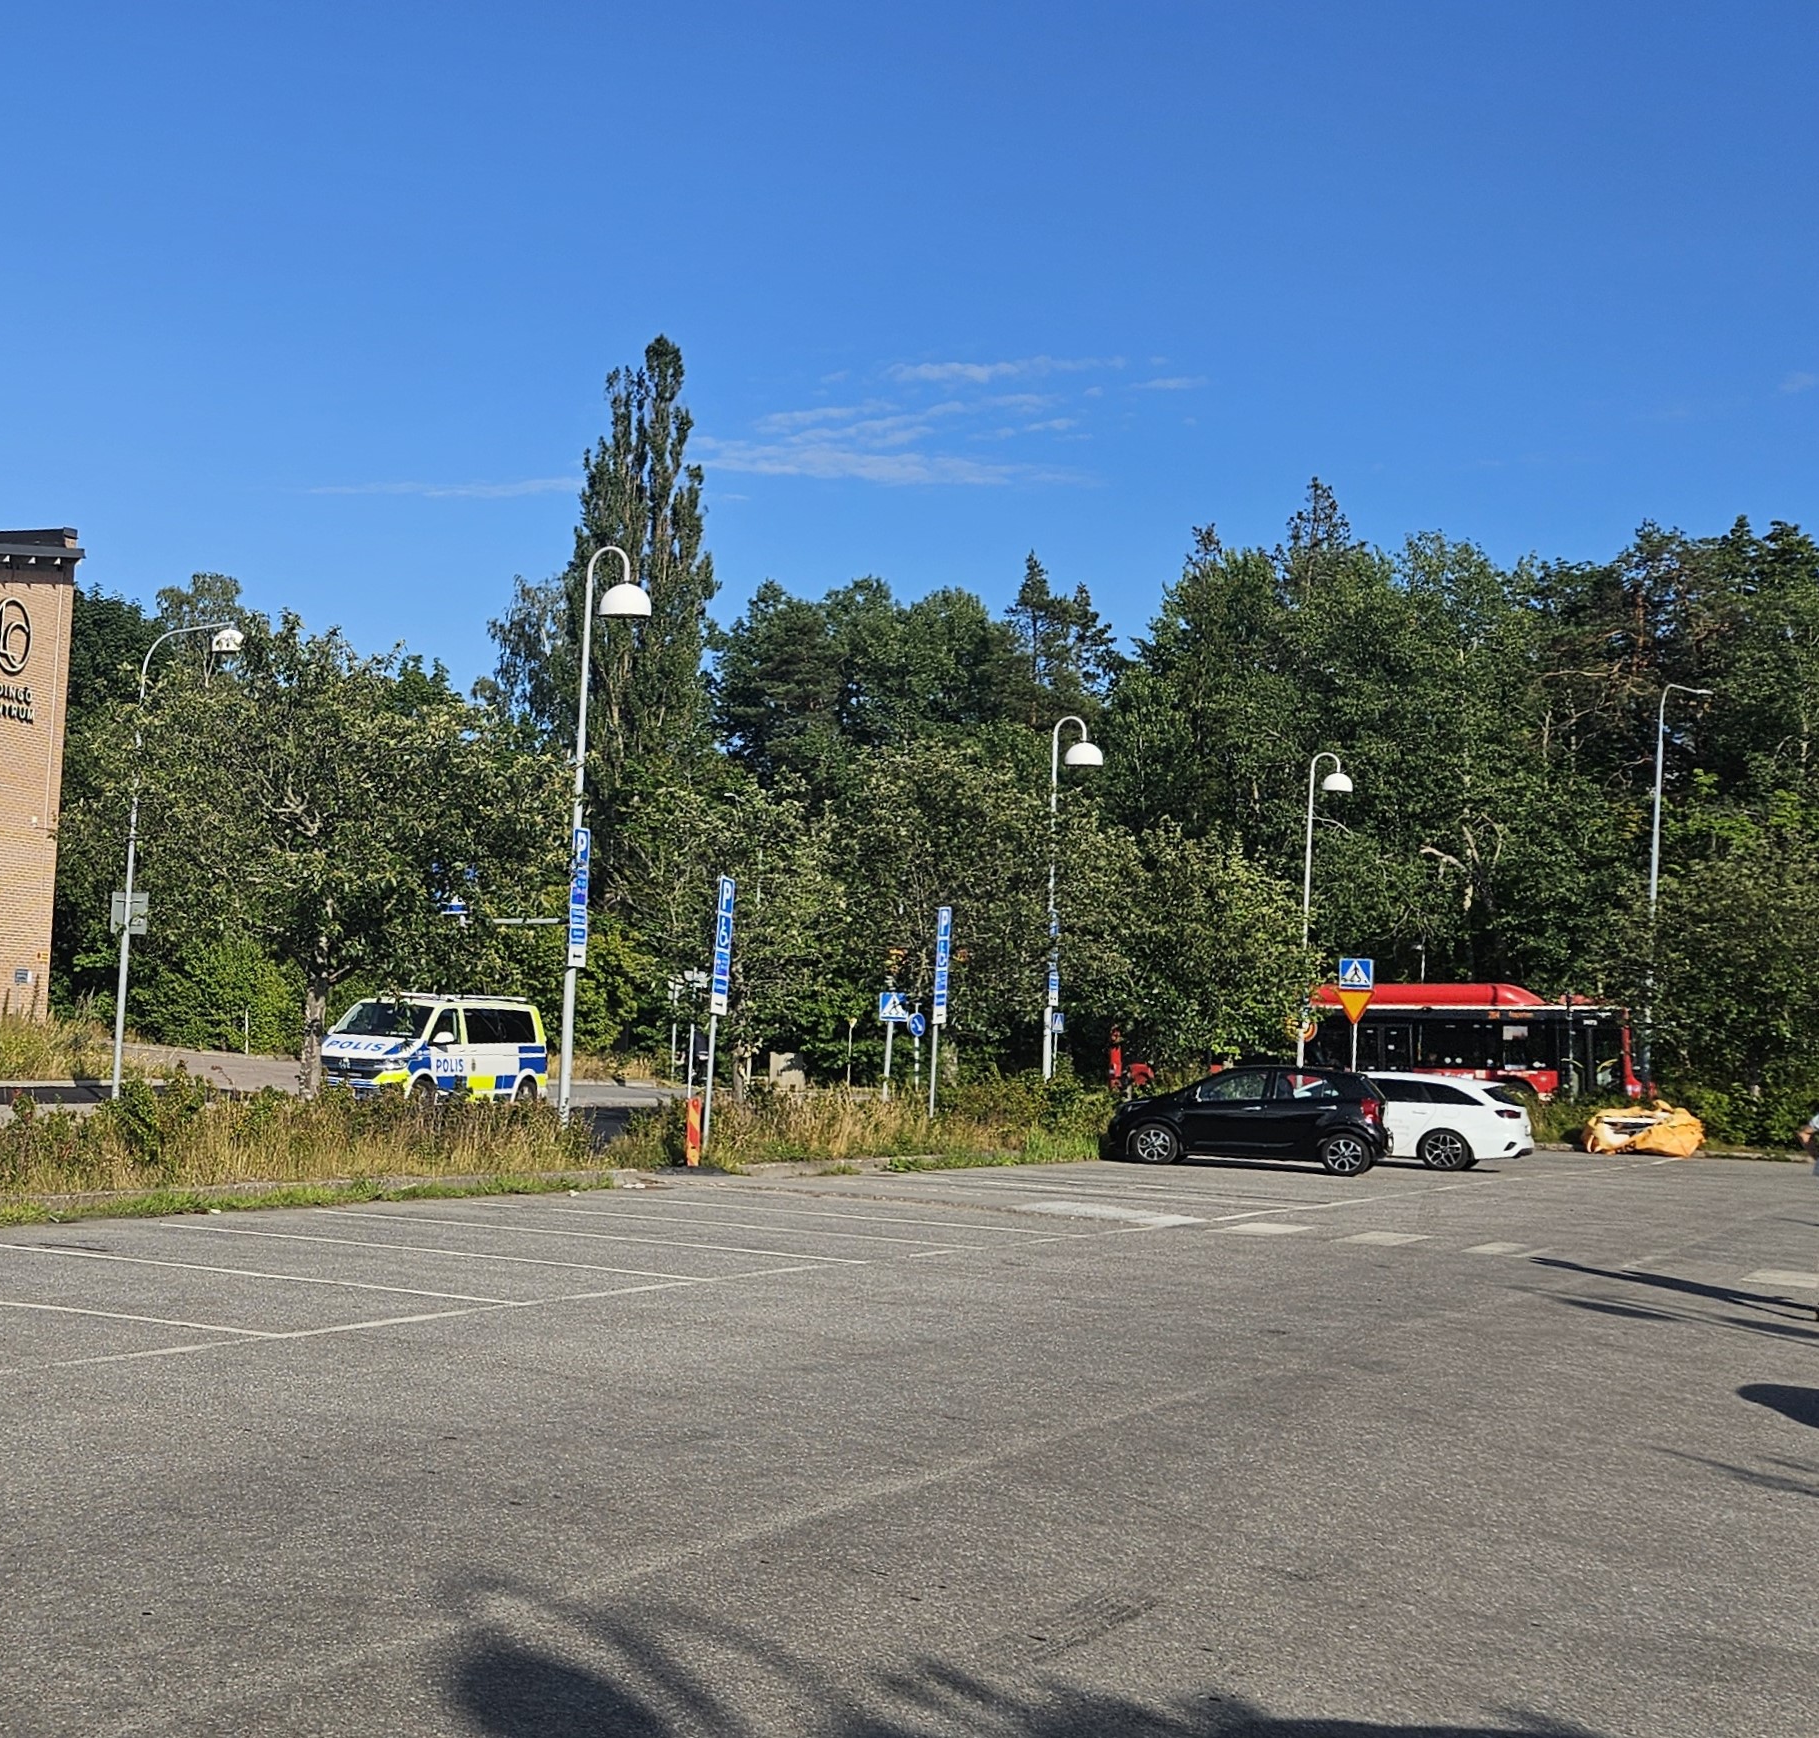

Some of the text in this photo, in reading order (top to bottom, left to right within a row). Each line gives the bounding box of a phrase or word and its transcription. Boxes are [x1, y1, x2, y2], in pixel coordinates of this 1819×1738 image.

[576, 831, 587, 861] P
[722, 881, 732, 910] P
[940, 910, 949, 936] P
[325, 1039, 386, 1052] POLIS
[435, 1058, 465, 1073] POLIS
